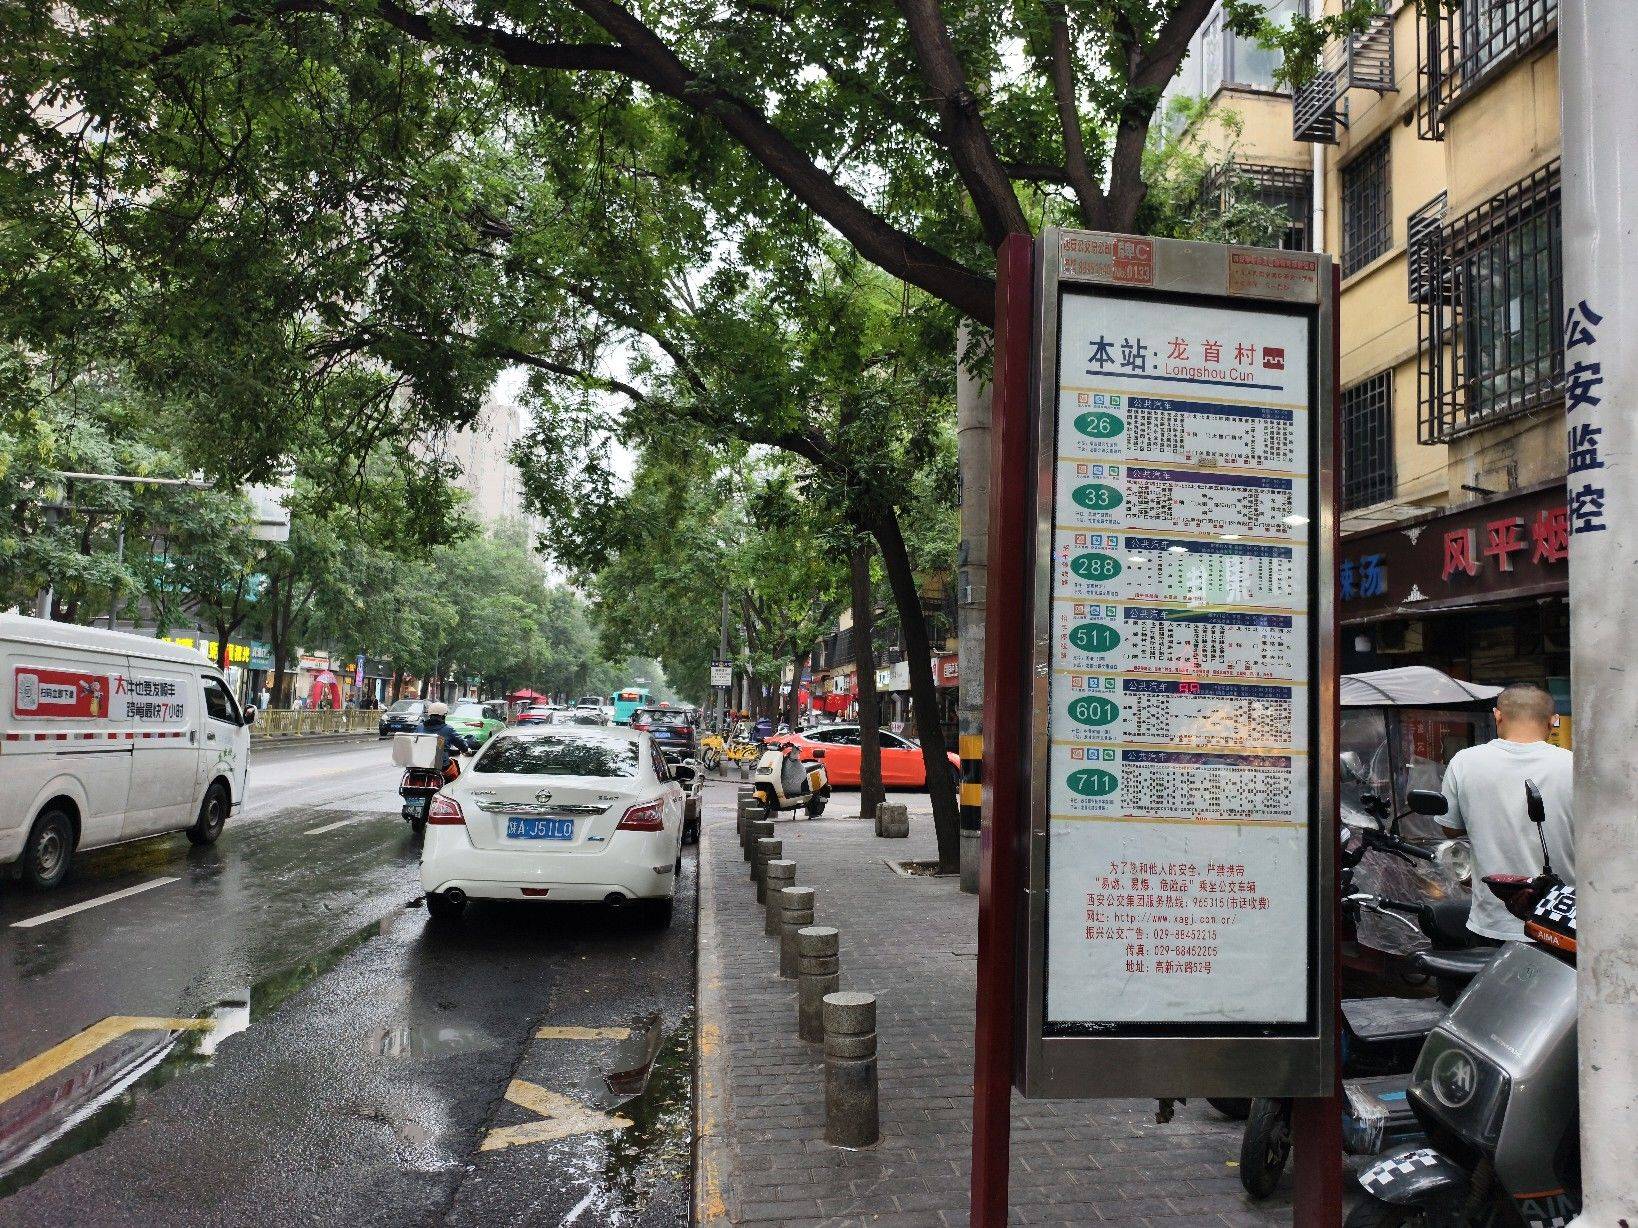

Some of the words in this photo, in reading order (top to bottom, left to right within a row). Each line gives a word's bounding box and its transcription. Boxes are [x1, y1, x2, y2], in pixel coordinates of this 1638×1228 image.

[1167, 336, 1257, 366] 龙首村
[1165, 362, 1226, 381] Longshou
[1230, 367, 1254, 382] Cun
[1133, 399, 1172, 410] 公共汽车
[1087, 417, 1112, 434] 26
[1563, 300, 1606, 535] 公安监控
[1132, 468, 1171, 480] 公共汽车
[1084, 488, 1110, 506] 33
[1078, 558, 1115, 575] 288
[1129, 608, 1169, 620] 公共汽车
[1076, 629, 1111, 648] 511
[114, 675, 176, 698] 大件也要发顺丰
[1128, 680, 1168, 692] 公共汽车
[126, 701, 184, 722] 跨省最快7小时
[1076, 702, 1112, 721] 601
[1127, 751, 1167, 762] 公共汽车
[1076, 774, 1110, 791] 711
[1537, 930, 1560, 947] AIMA
